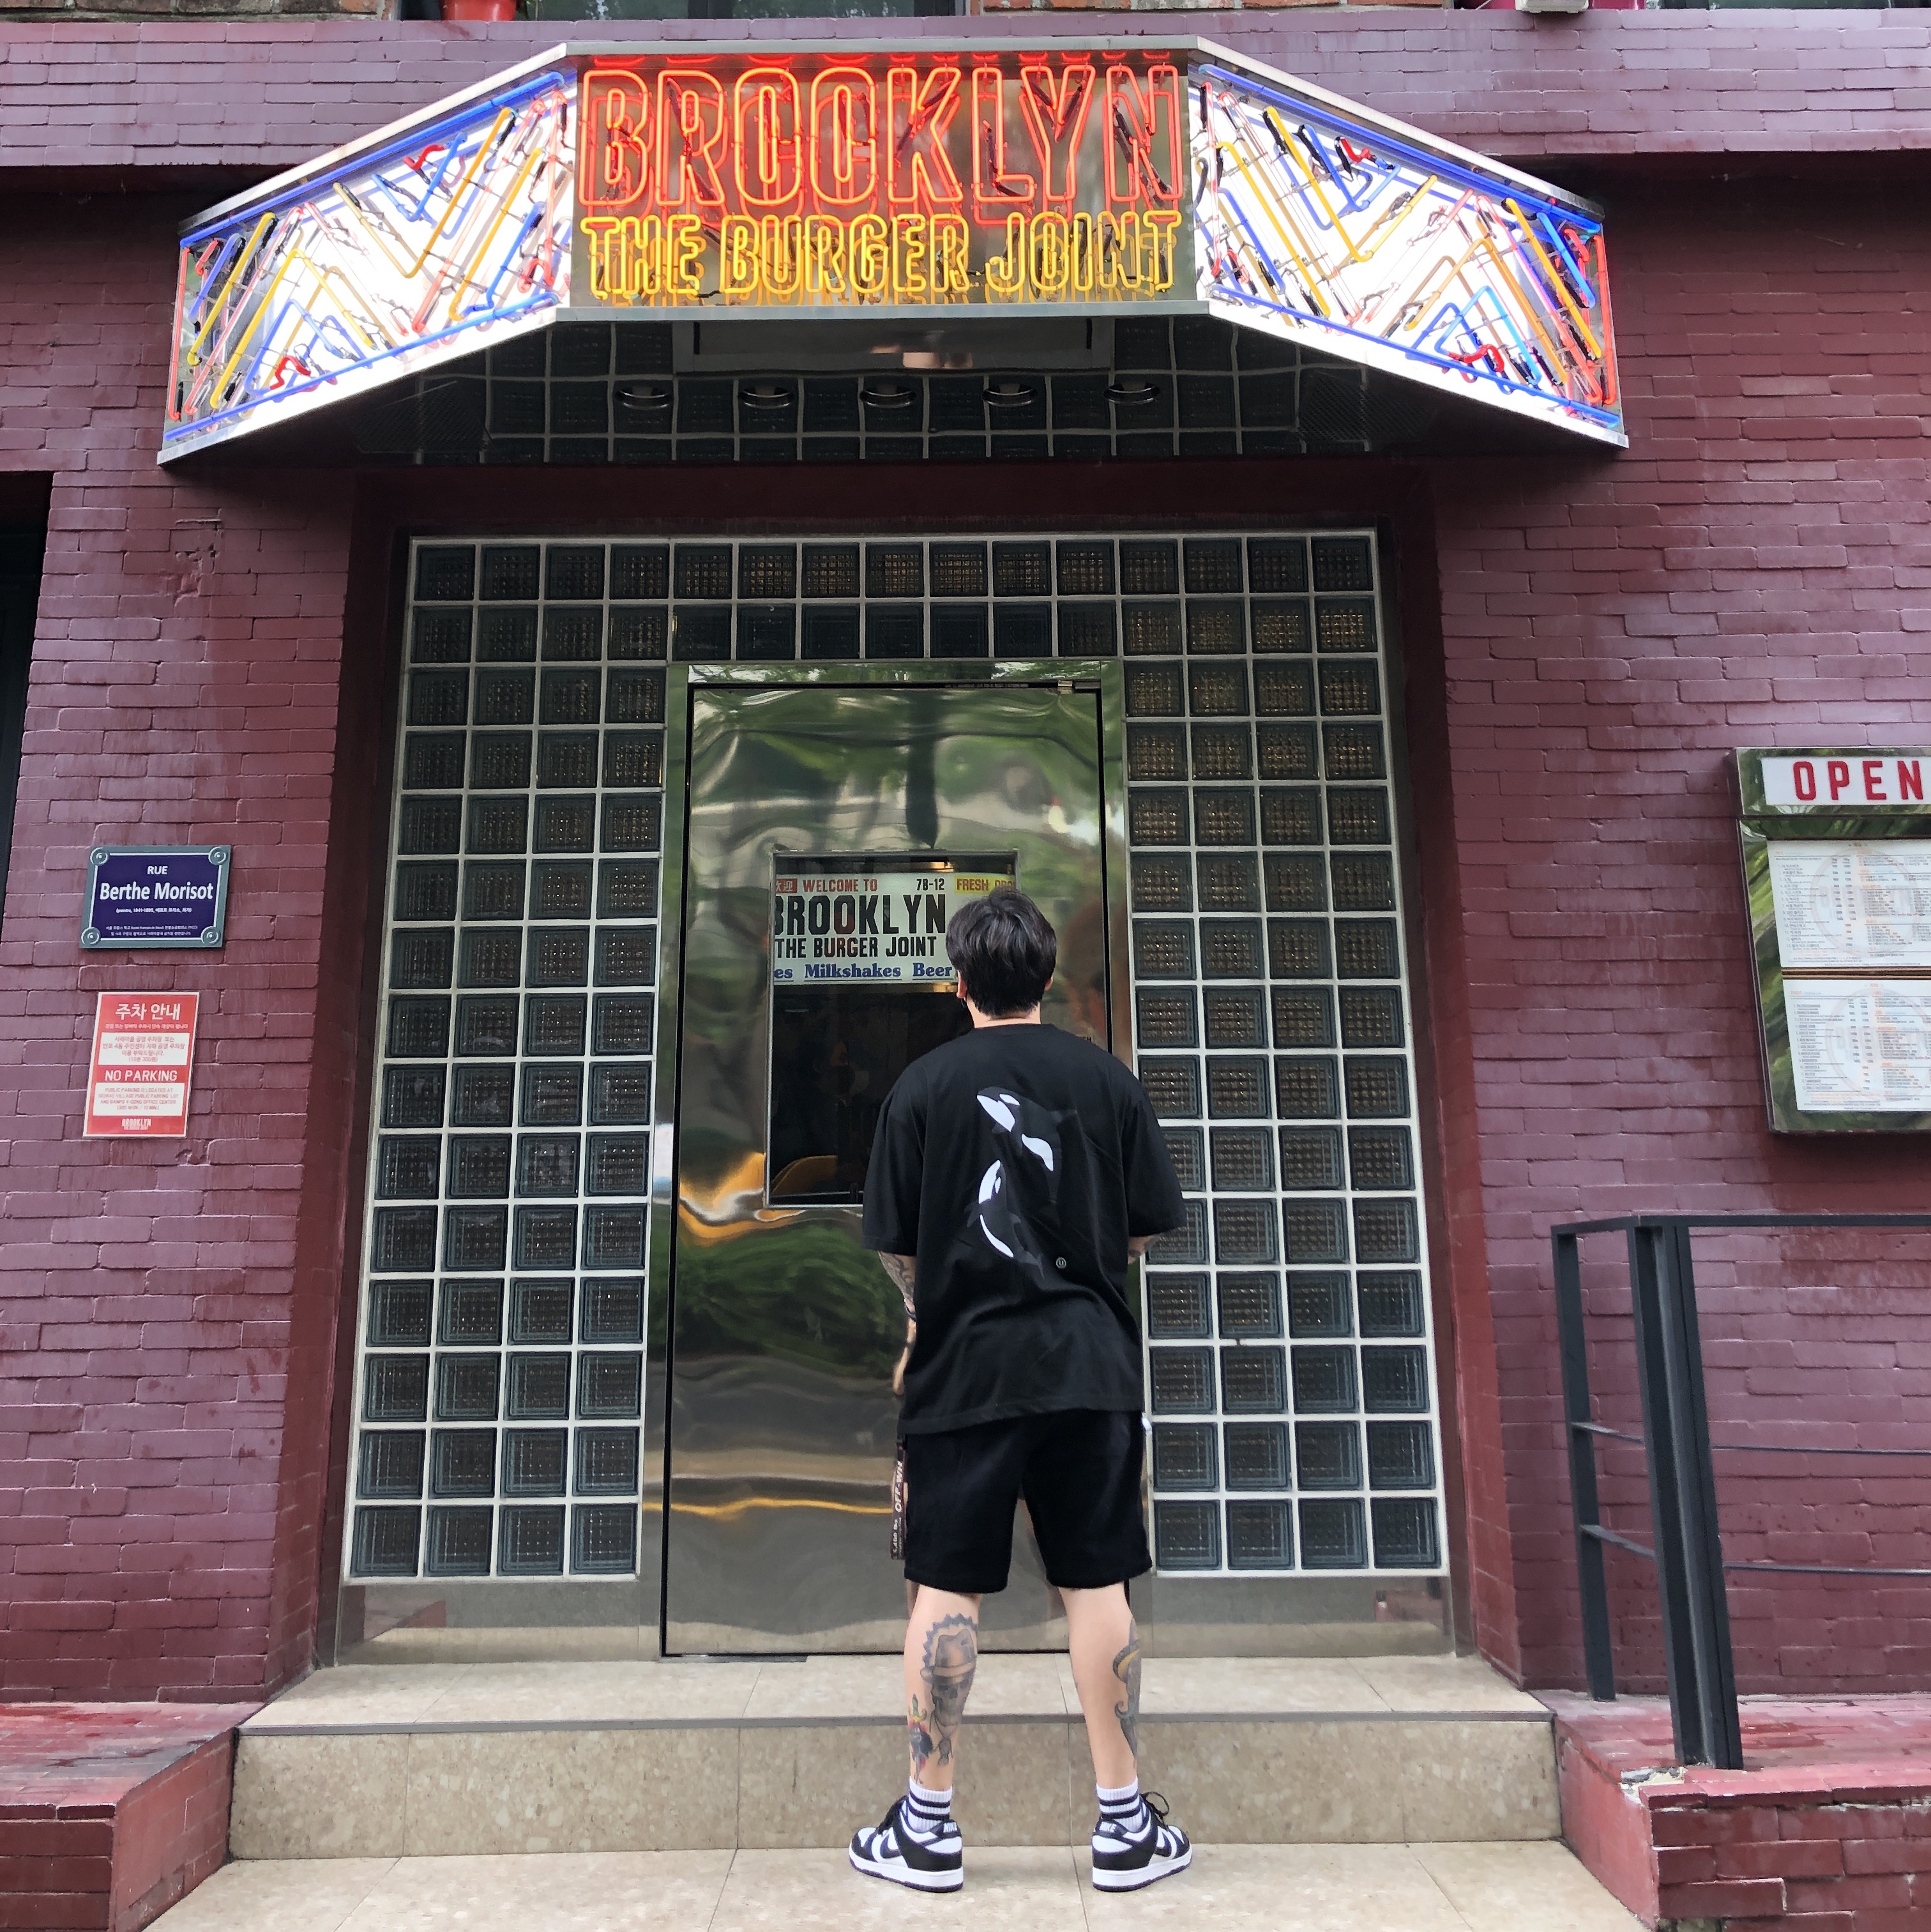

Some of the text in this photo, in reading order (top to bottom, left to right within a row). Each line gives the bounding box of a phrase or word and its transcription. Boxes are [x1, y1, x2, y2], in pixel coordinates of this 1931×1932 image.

[579, 65, 1183, 206] BROOKLYN
[580, 210, 1182, 299] THE BURGER JOINT
[1792, 760, 1923, 800] OPEN
[147, 865, 168, 875] RUE
[100, 881, 213, 900] Berthe Morisot
[803, 879, 877, 893] WELCOME TO
[916, 878, 945, 891] 78-12
[957, 879, 989, 892] FRESH
[775, 936, 937, 958] THE BURGER JOINT
[805, 963, 901, 978] Milkshakes
[912, 962, 952, 977] Beer
[115, 1003, 181, 1021] 주차 안내
[105, 1070, 178, 1081] NO PARKING
[1099, 1822, 1117, 1832] NIKE
